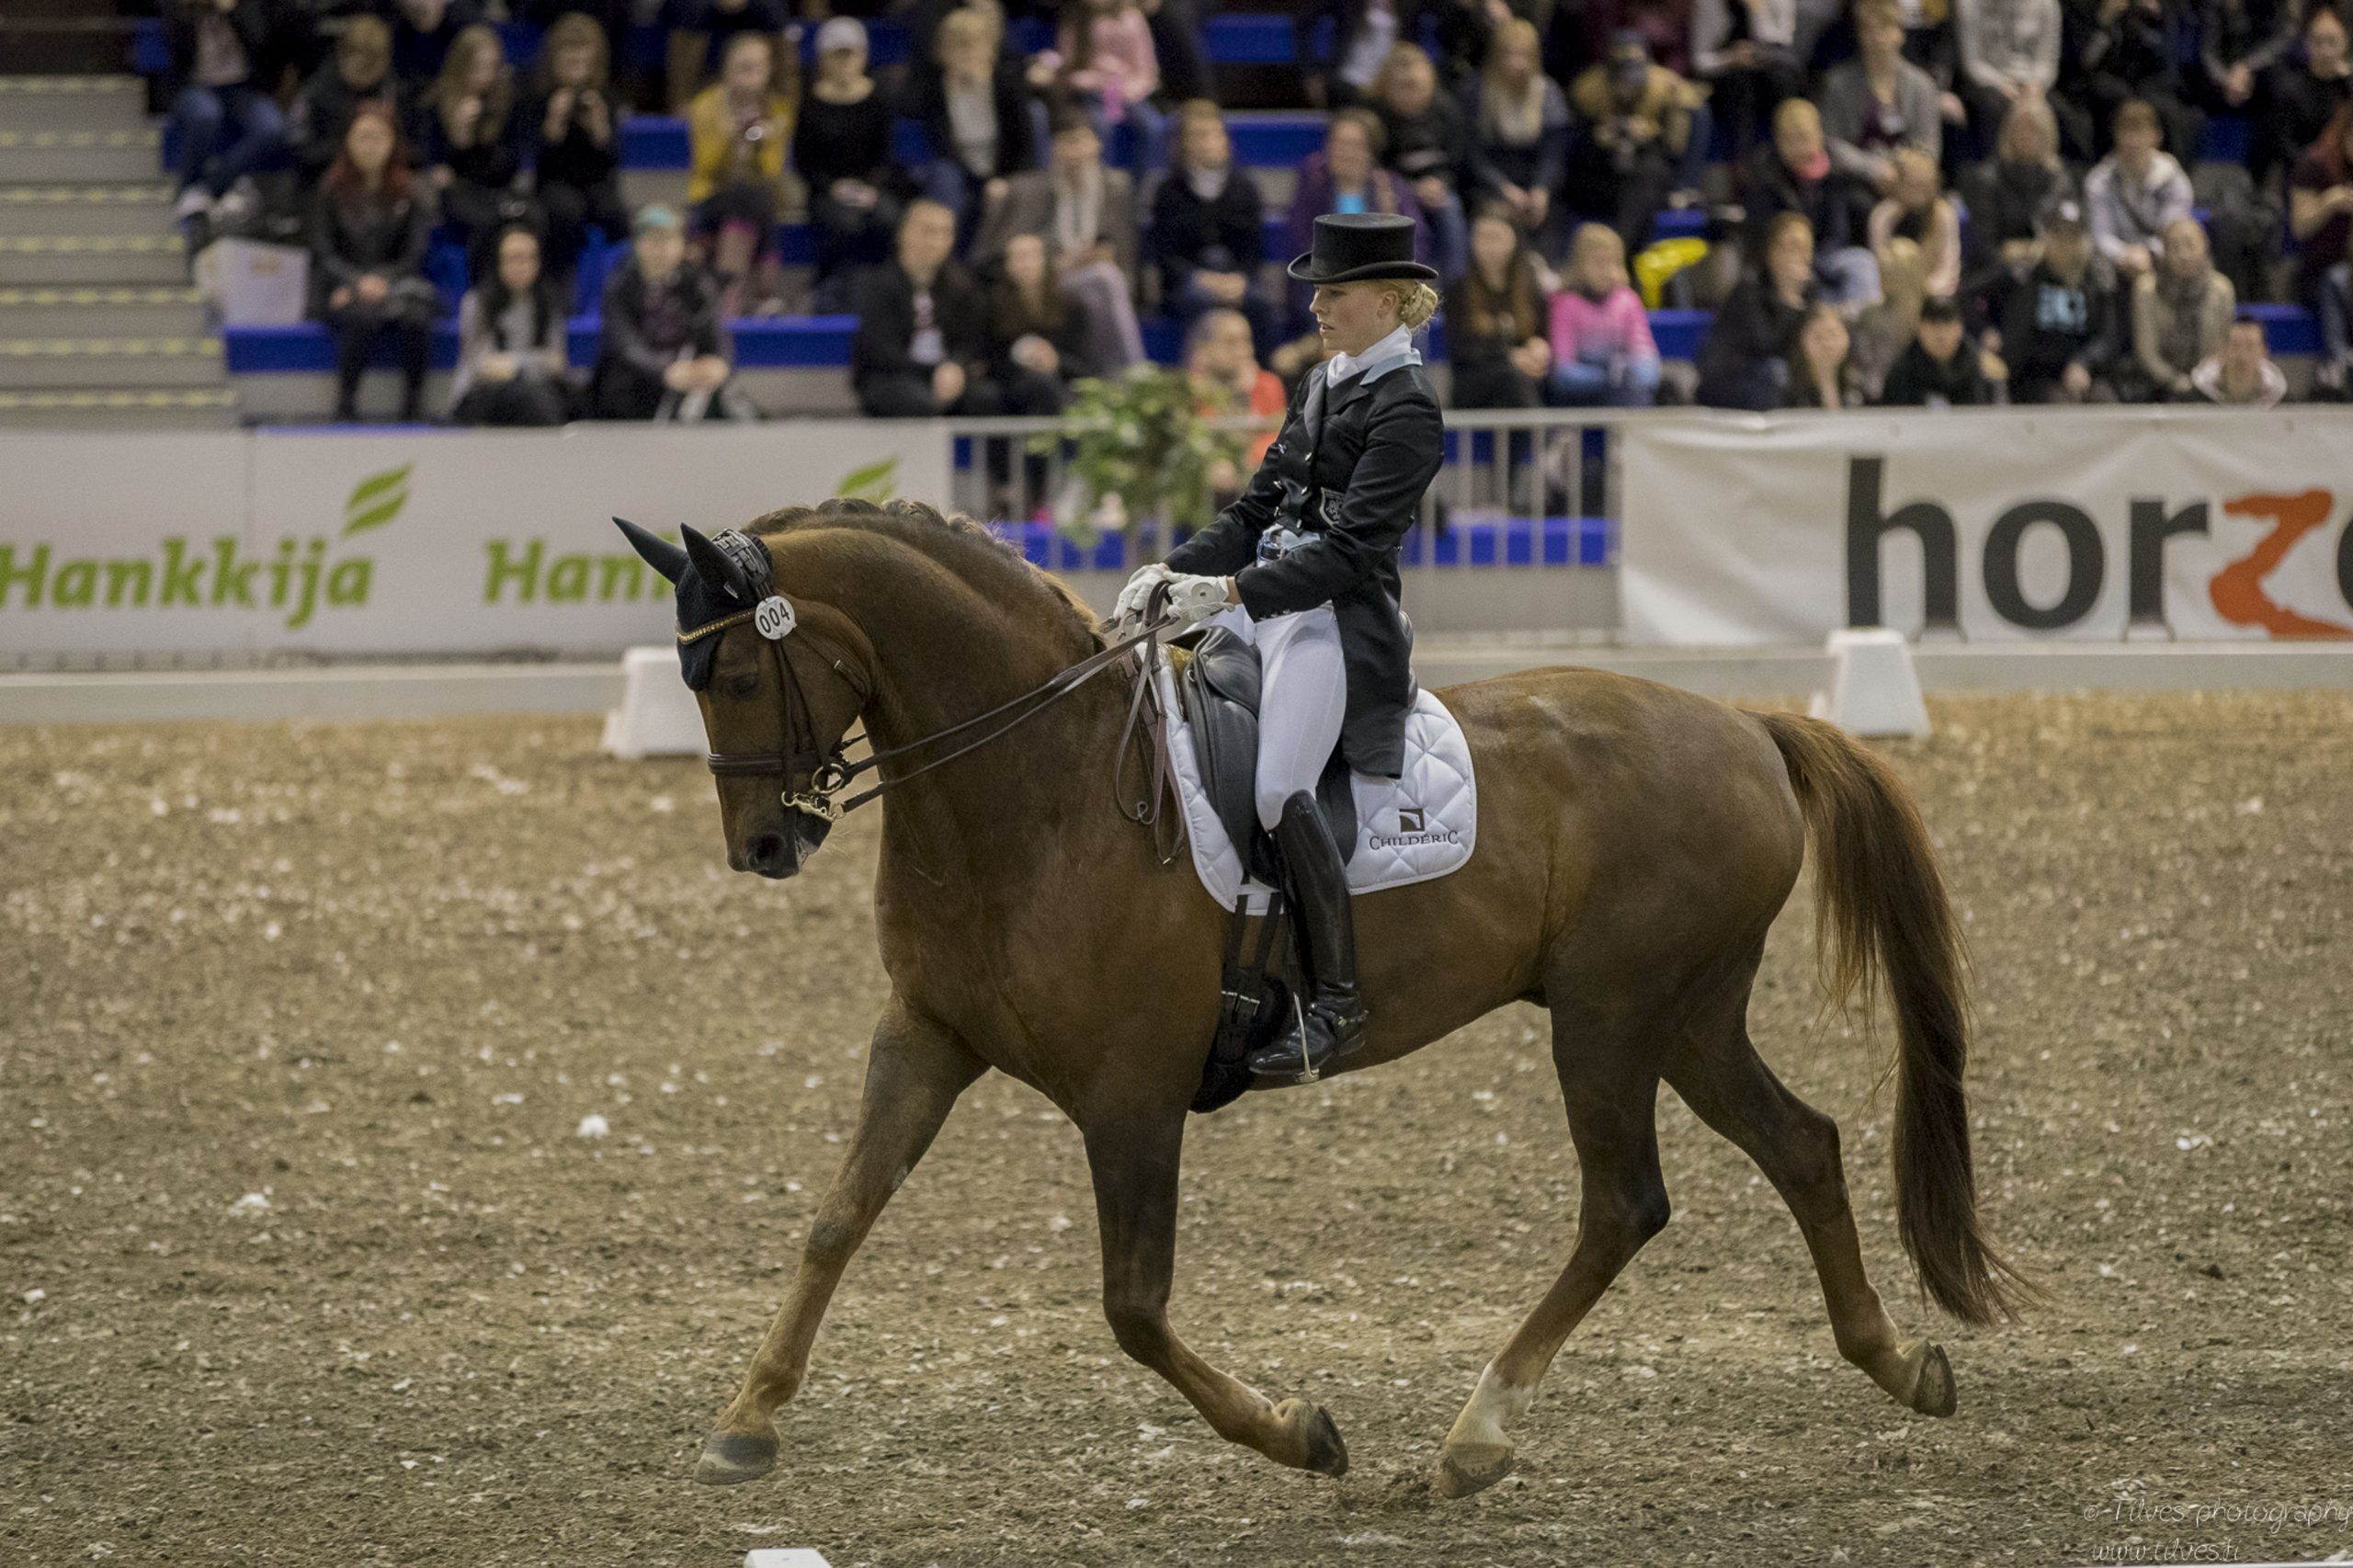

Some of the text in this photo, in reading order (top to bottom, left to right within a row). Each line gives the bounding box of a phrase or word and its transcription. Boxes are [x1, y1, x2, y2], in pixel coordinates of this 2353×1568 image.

[0, 534, 373, 631] Hankkija
[1846, 457, 2353, 640] horz
[759, 602, 790, 634] 004
